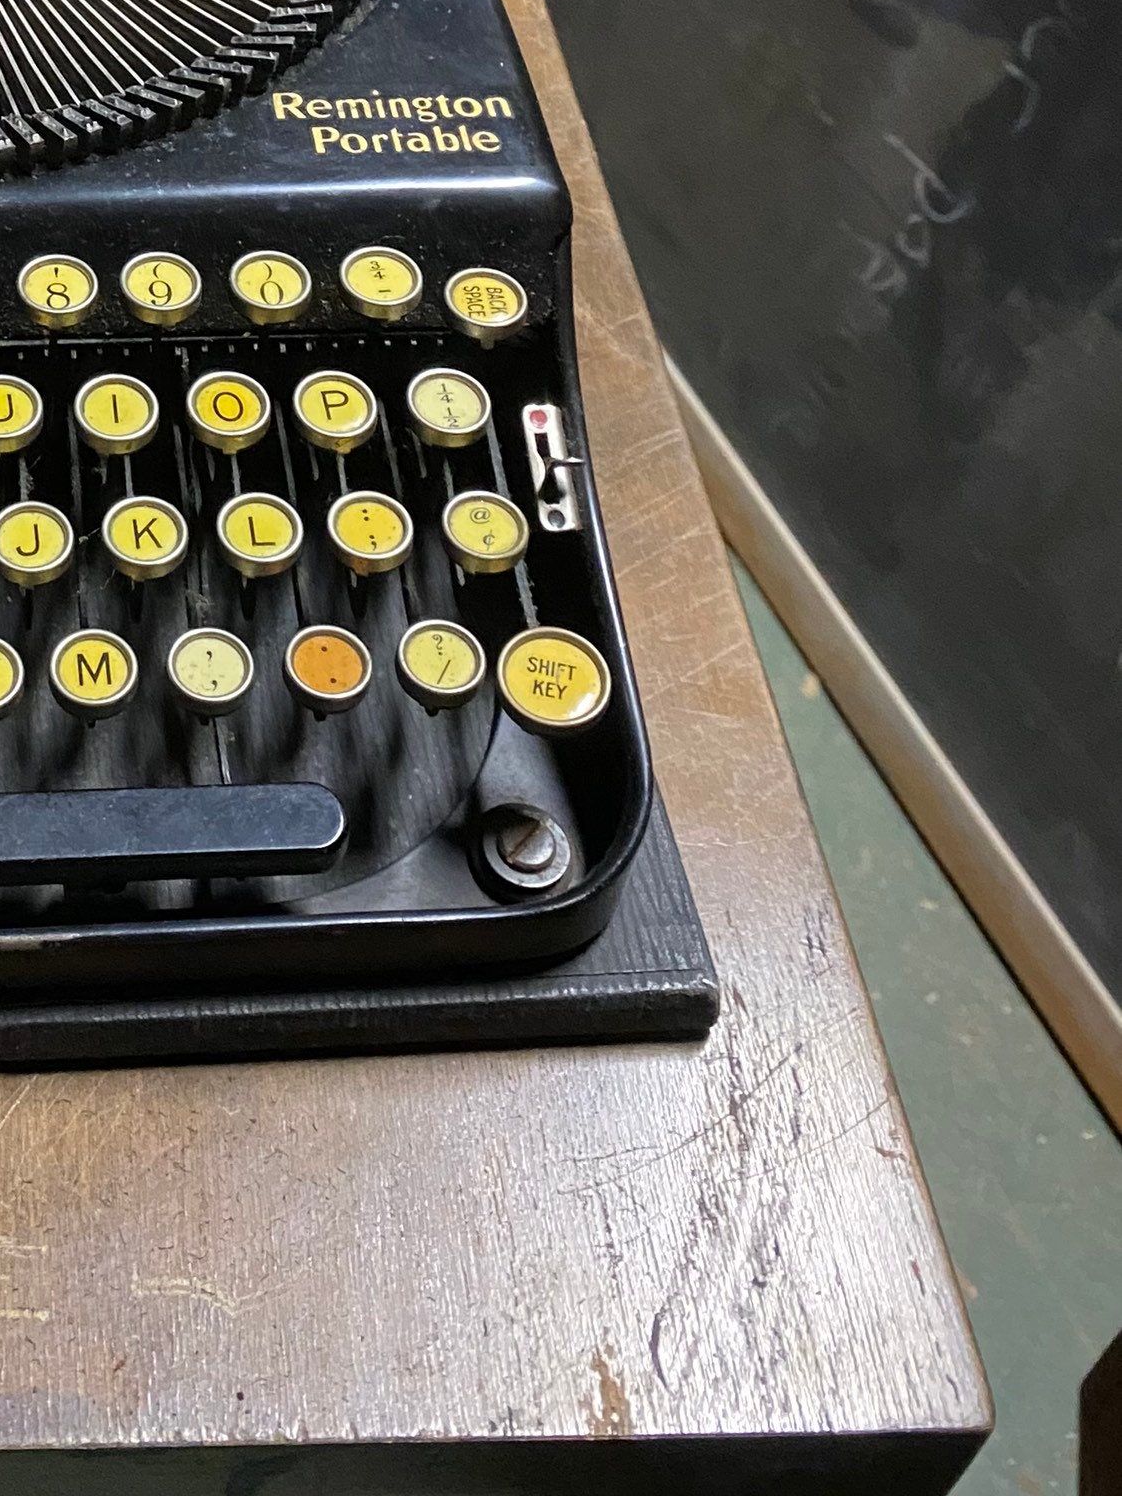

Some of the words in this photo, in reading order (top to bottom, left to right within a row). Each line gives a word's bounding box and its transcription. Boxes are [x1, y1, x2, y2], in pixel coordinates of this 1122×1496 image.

[272, 89, 514, 123] Remington
[311, 125, 502, 154] Portable
[46, 283, 70, 308] 8
[149, 281, 172, 305] 9
[464, 286, 487, 318] SPACE
[486, 287, 508, 315] BACK
[111, 394, 119, 423] I
[213, 392, 243, 422] O
[321, 390, 349, 420] P
[470, 508, 491, 524] @
[15, 524, 39, 557] J
[133, 518, 163, 549] K
[248, 517, 276, 546] L
[76, 652, 112, 687] M
[526, 656, 577, 681] SHIFT
[533, 680, 568, 700] KEY
